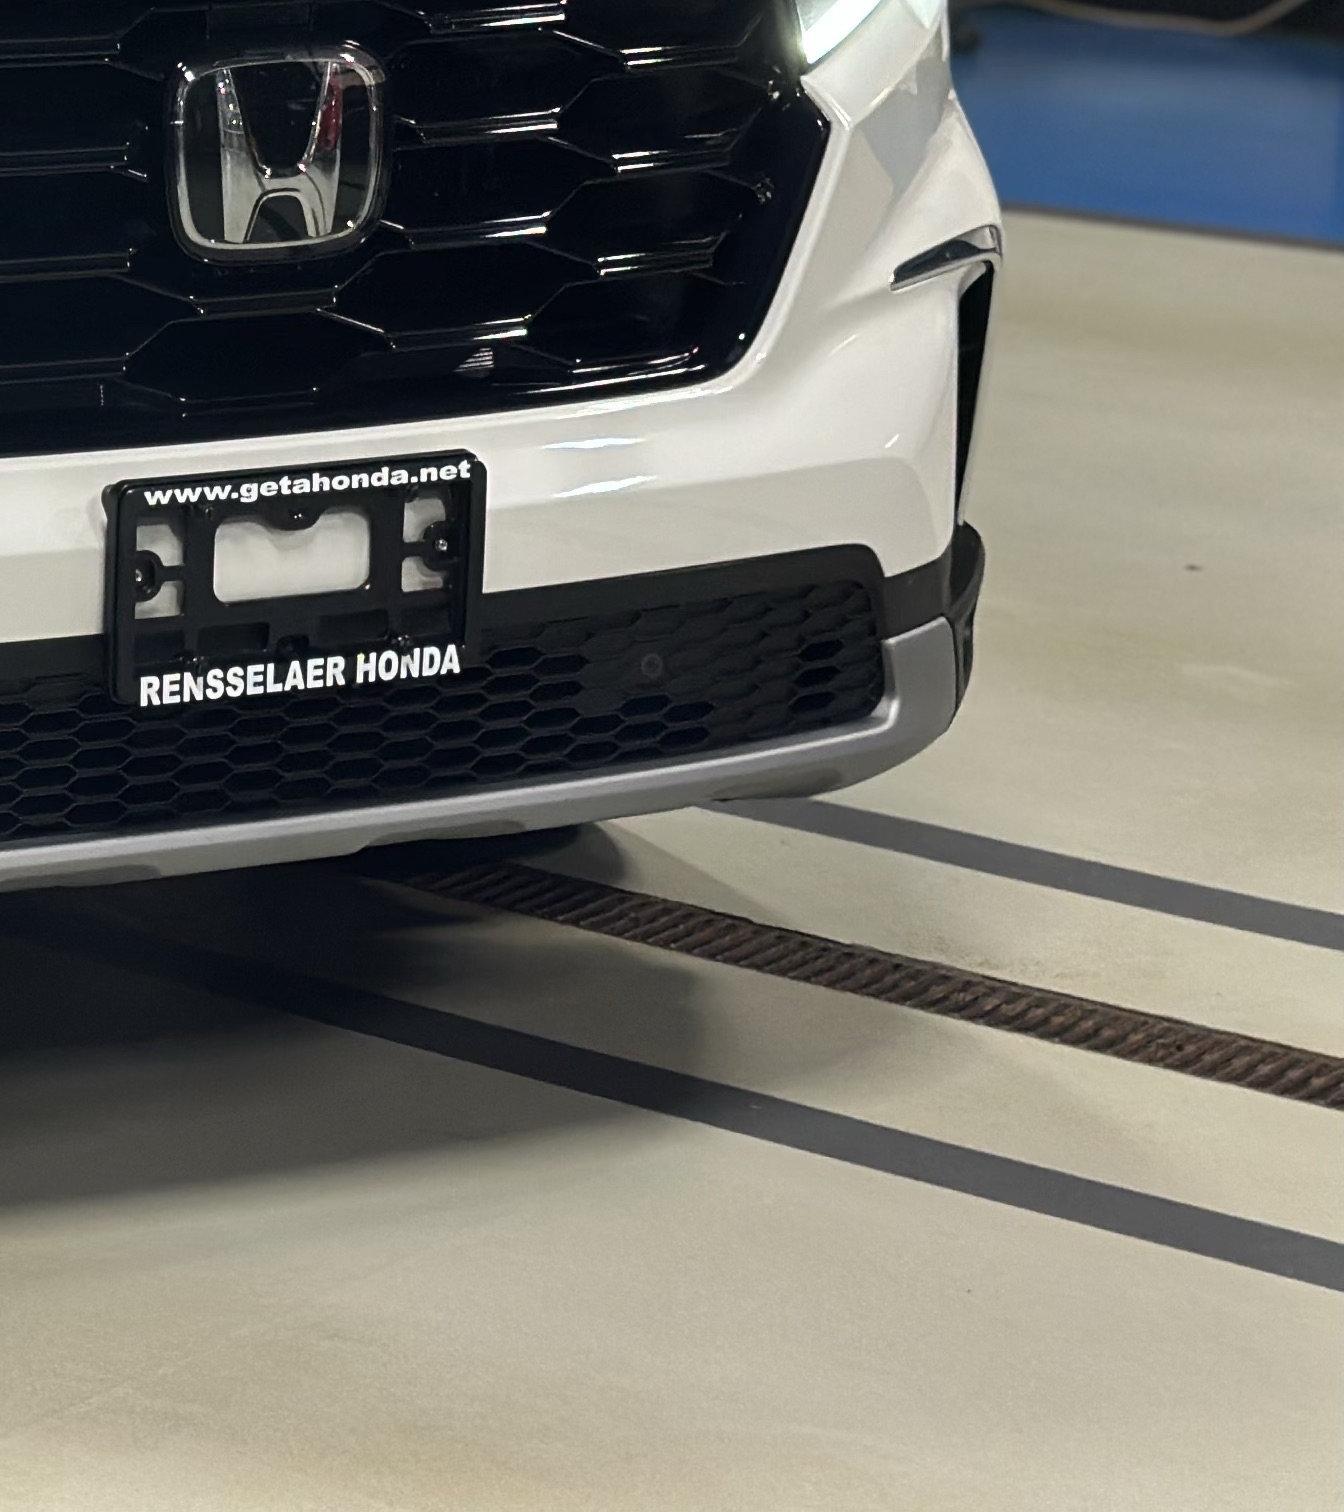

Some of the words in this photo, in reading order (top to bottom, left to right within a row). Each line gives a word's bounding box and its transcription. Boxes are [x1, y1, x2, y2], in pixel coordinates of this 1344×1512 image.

[144, 459, 471, 506] www.getahonda.net
[139, 656, 346, 707] RENSSELAER
[356, 643, 461, 684] HONDA
